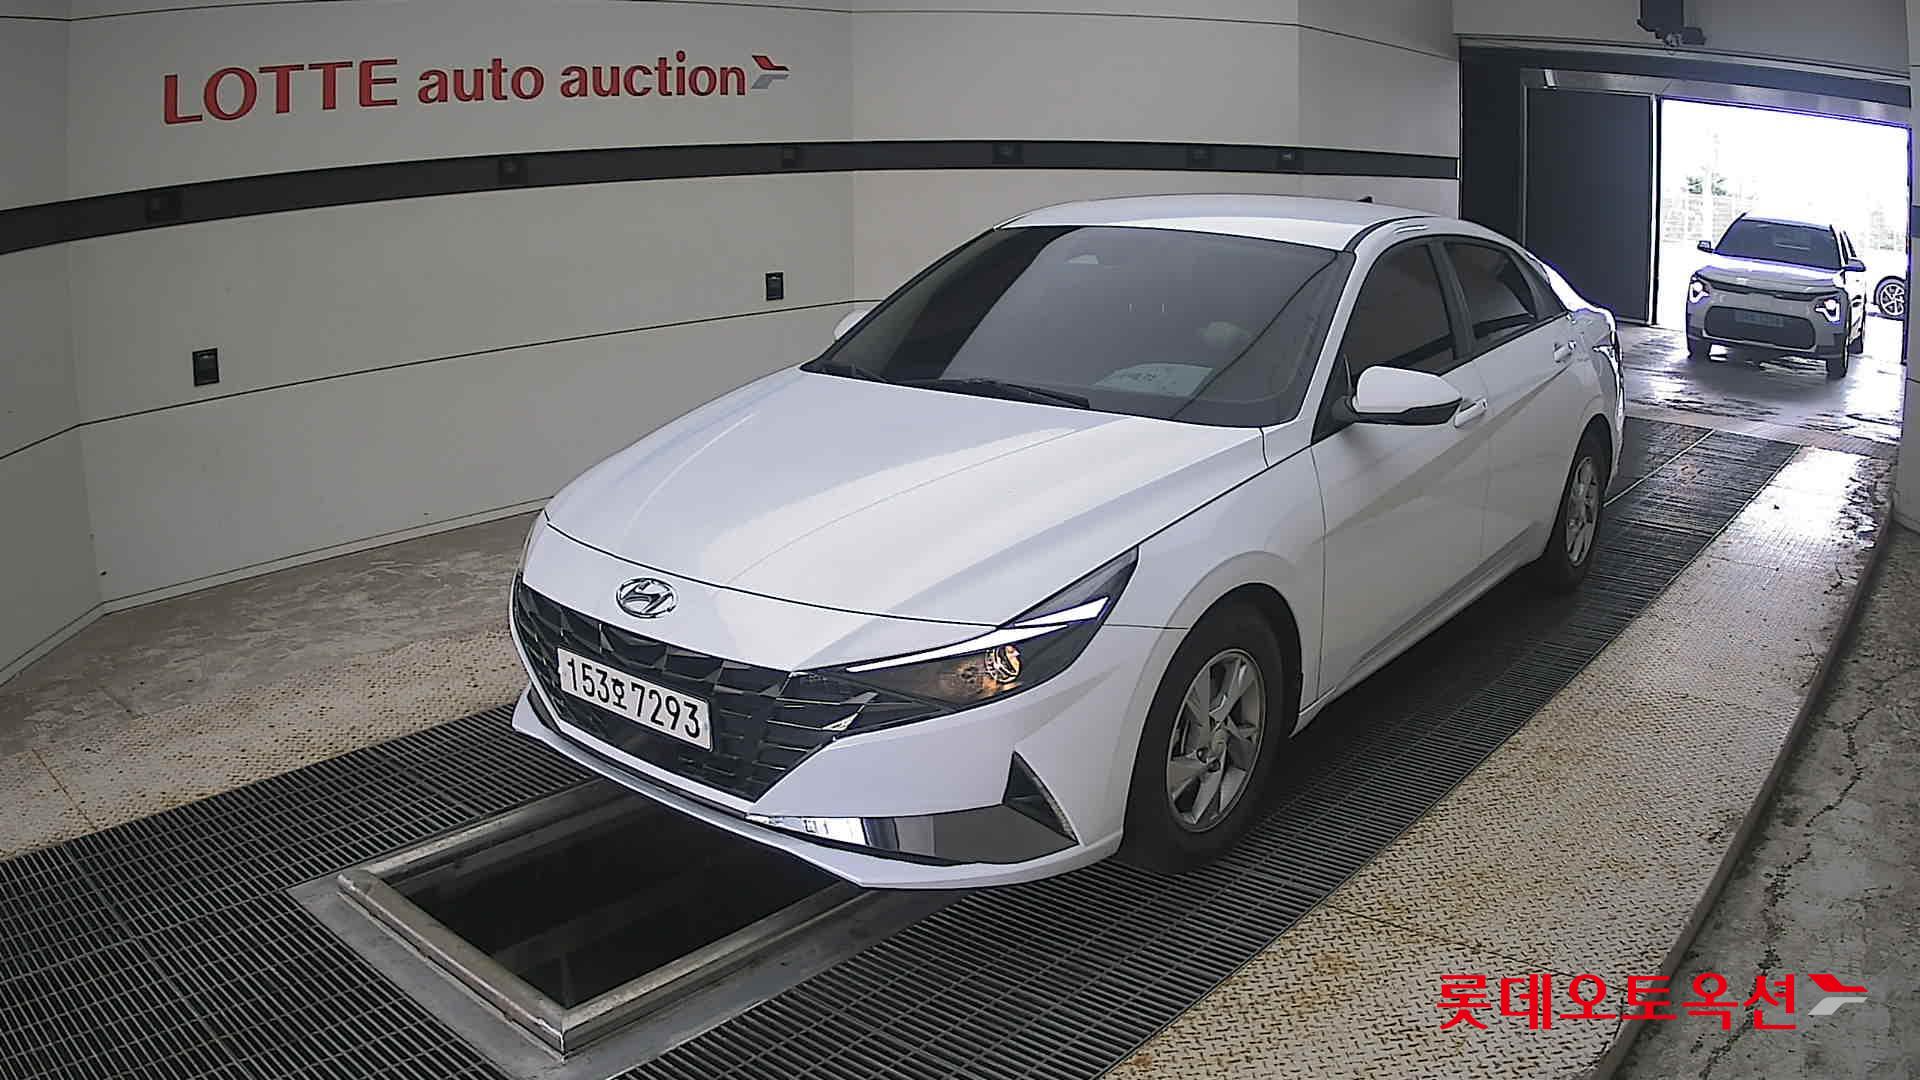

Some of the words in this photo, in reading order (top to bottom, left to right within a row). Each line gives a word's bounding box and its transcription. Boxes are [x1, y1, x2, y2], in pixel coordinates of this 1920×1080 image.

[163, 58, 399, 125] LOTTE
[417, 56, 545, 104] auto
[560, 50, 747, 98] auction
